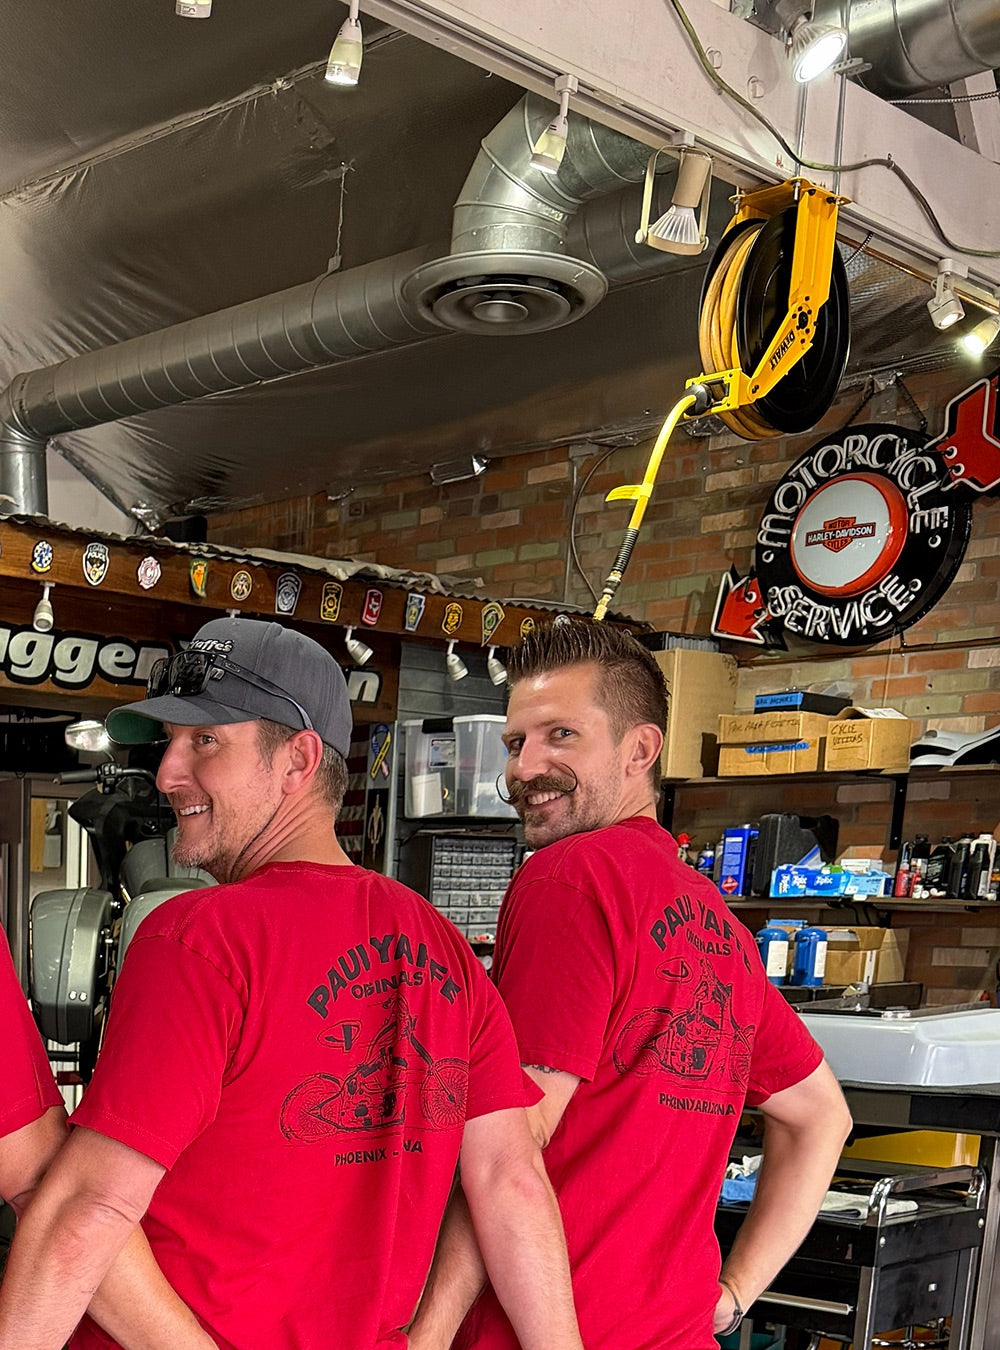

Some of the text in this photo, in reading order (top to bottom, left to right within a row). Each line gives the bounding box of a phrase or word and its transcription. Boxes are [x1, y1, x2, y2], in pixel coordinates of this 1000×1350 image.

[757, 434, 949, 548] MOTORCYCLE
[807, 525, 873, 543] HARLEY-DAVIDSON
[828, 519, 850, 529] MOTOR
[767, 574, 915, 640] SERVICE
[650, 894, 695, 951] PAUL
[335, 1148, 388, 1167] PHOENIX
